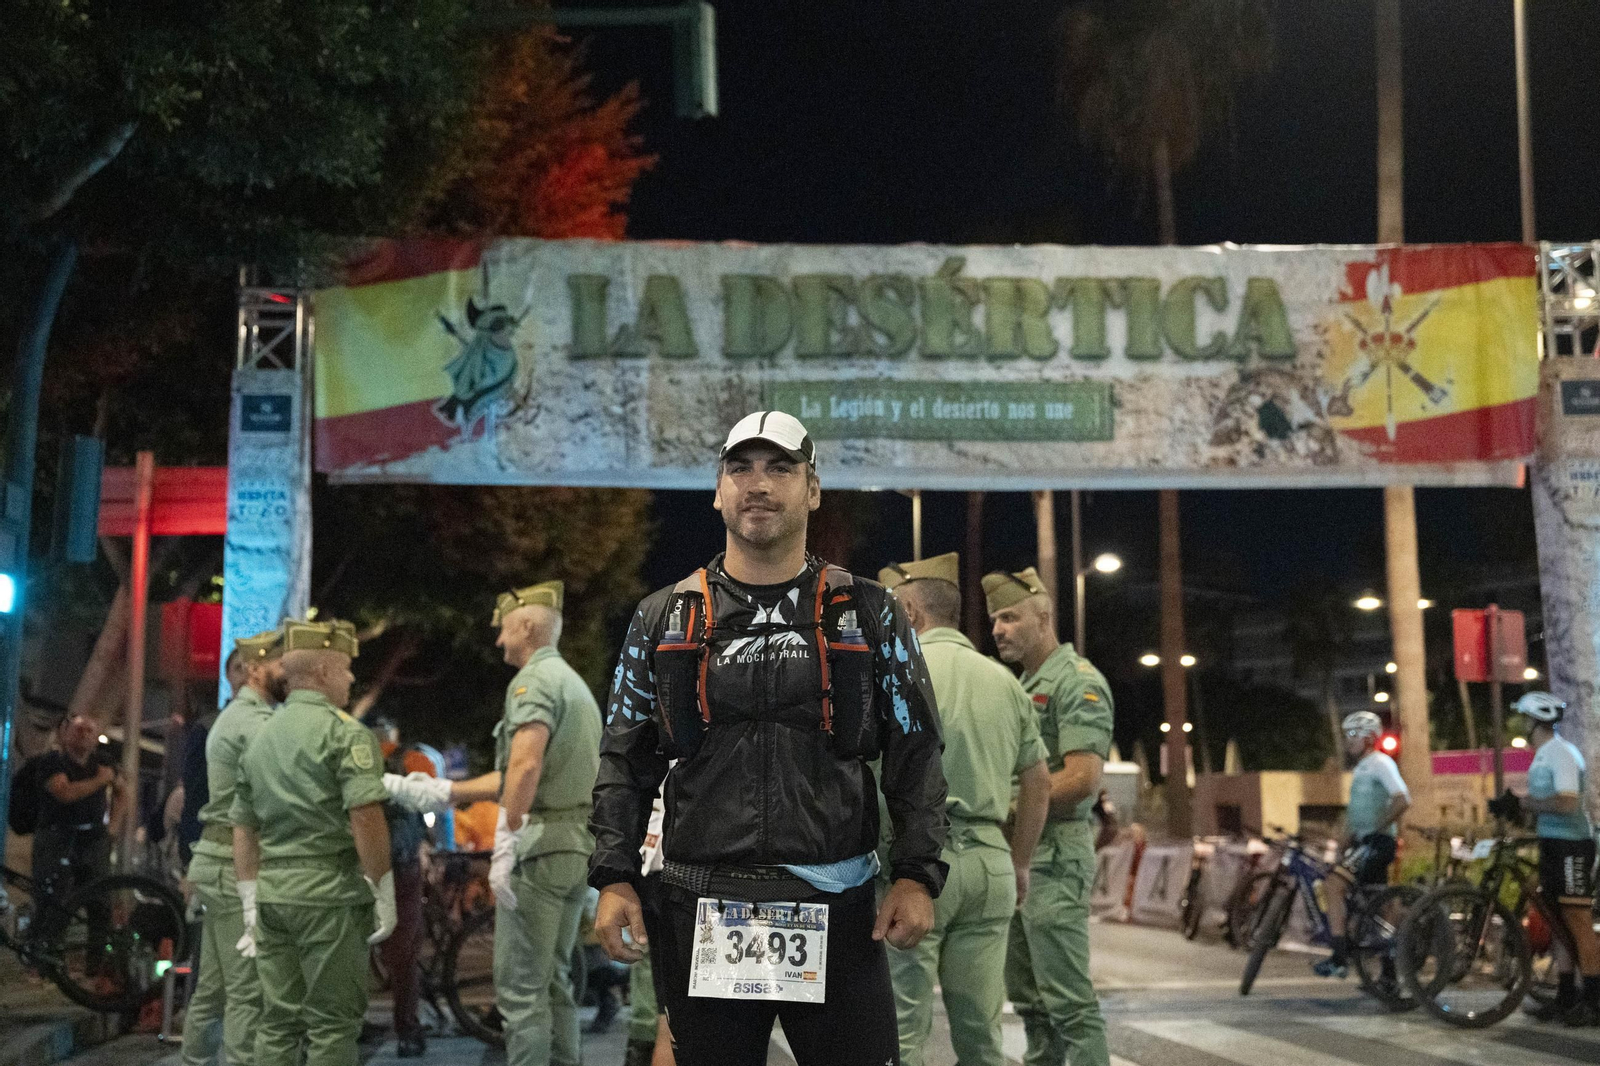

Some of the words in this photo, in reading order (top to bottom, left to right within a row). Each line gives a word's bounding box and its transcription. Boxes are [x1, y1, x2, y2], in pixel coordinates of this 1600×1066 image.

[566, 272, 699, 360] LA
[720, 255, 1296, 361] DESÉRTICA
[801, 396, 821, 418] La
[830, 396, 885, 422] Legión
[891, 402, 902, 422] y
[910, 397, 925, 419] el
[932, 397, 999, 419] desierto
[1008, 401, 1036, 419] nos
[1045, 401, 1073, 419] une
[716, 657, 731, 666] LA
[778, 649, 810, 660] TRAIL
[722, 907, 738, 919] LA
[741, 904, 817, 924] DSÉRTCA
[725, 930, 808, 967] 3493
[784, 970, 803, 979] IVAN
